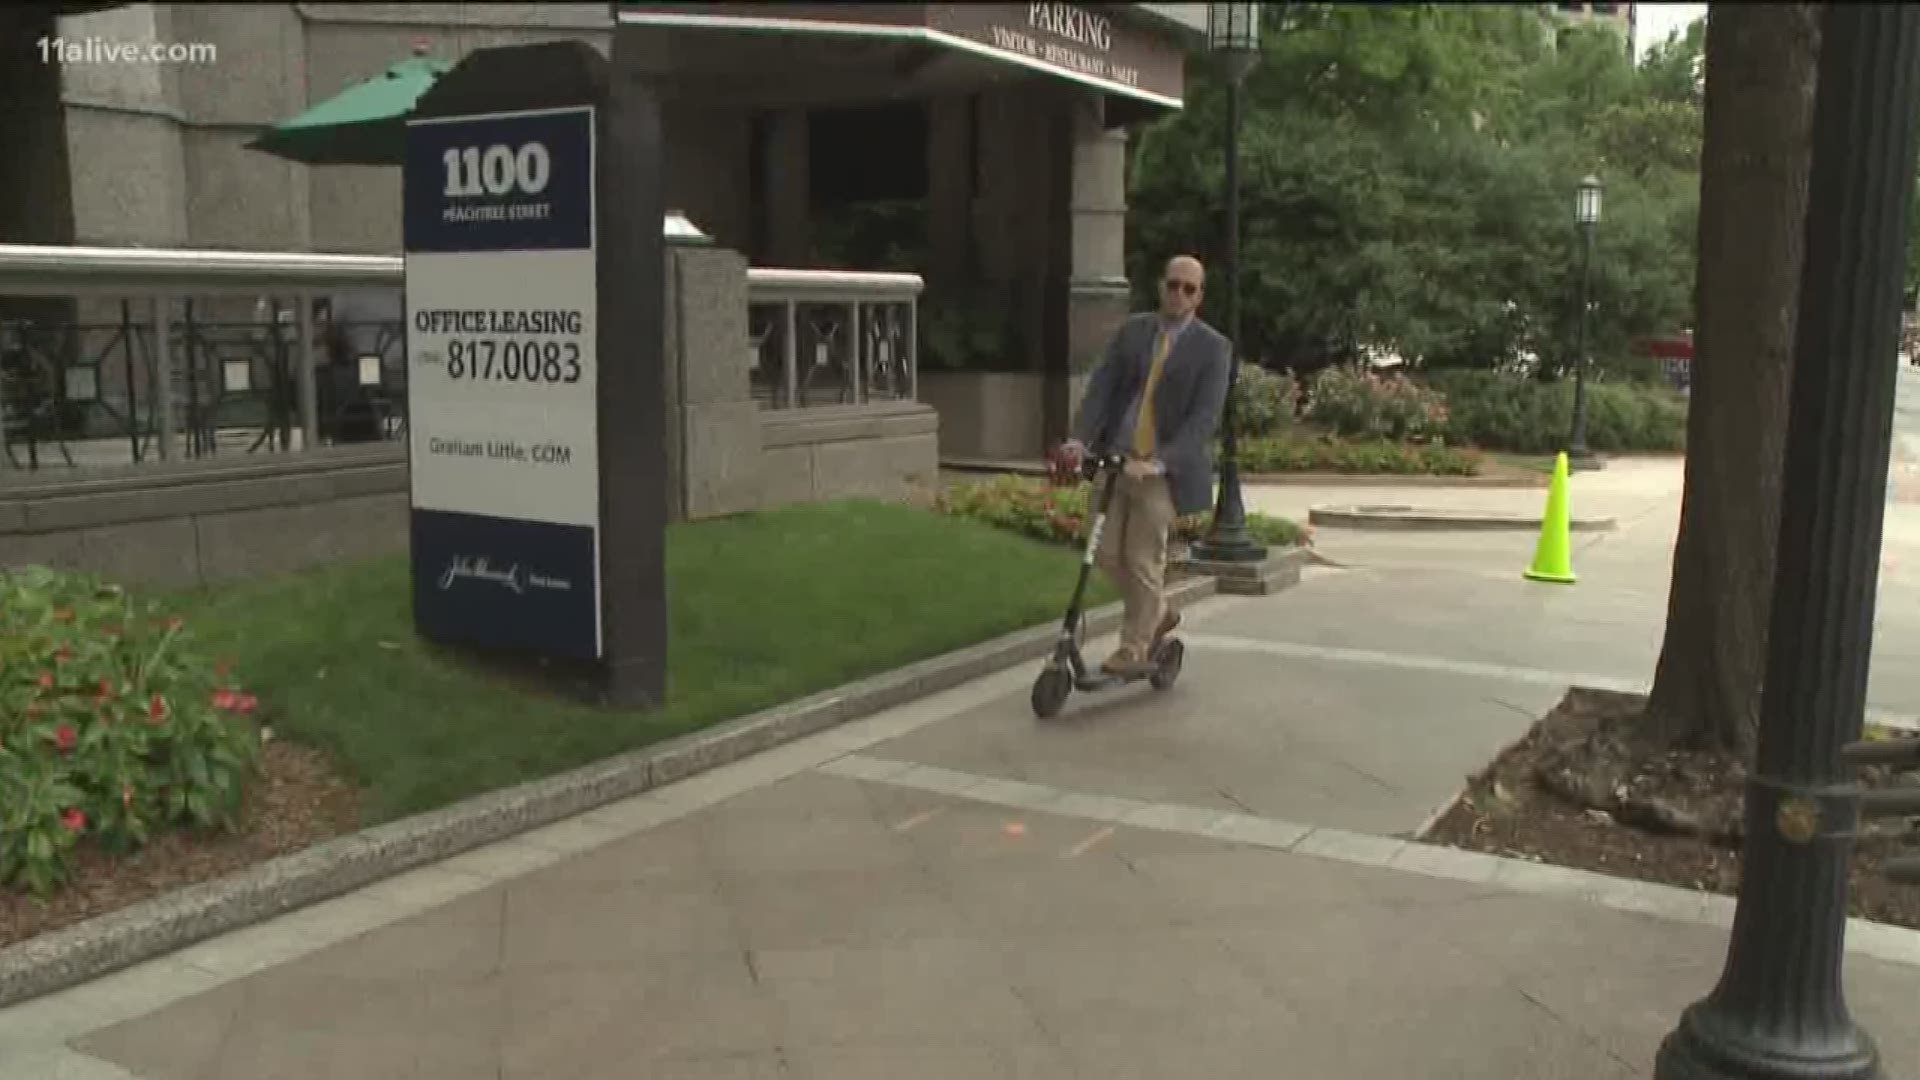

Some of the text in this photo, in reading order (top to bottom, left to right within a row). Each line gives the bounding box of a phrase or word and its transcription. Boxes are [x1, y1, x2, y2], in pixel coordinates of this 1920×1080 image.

[1028, 2, 1110, 50] PARKING
[443, 142, 550, 198] 1100
[415, 310, 582, 335] OFFICE LEASING
[448, 339, 581, 383] 817.0083
